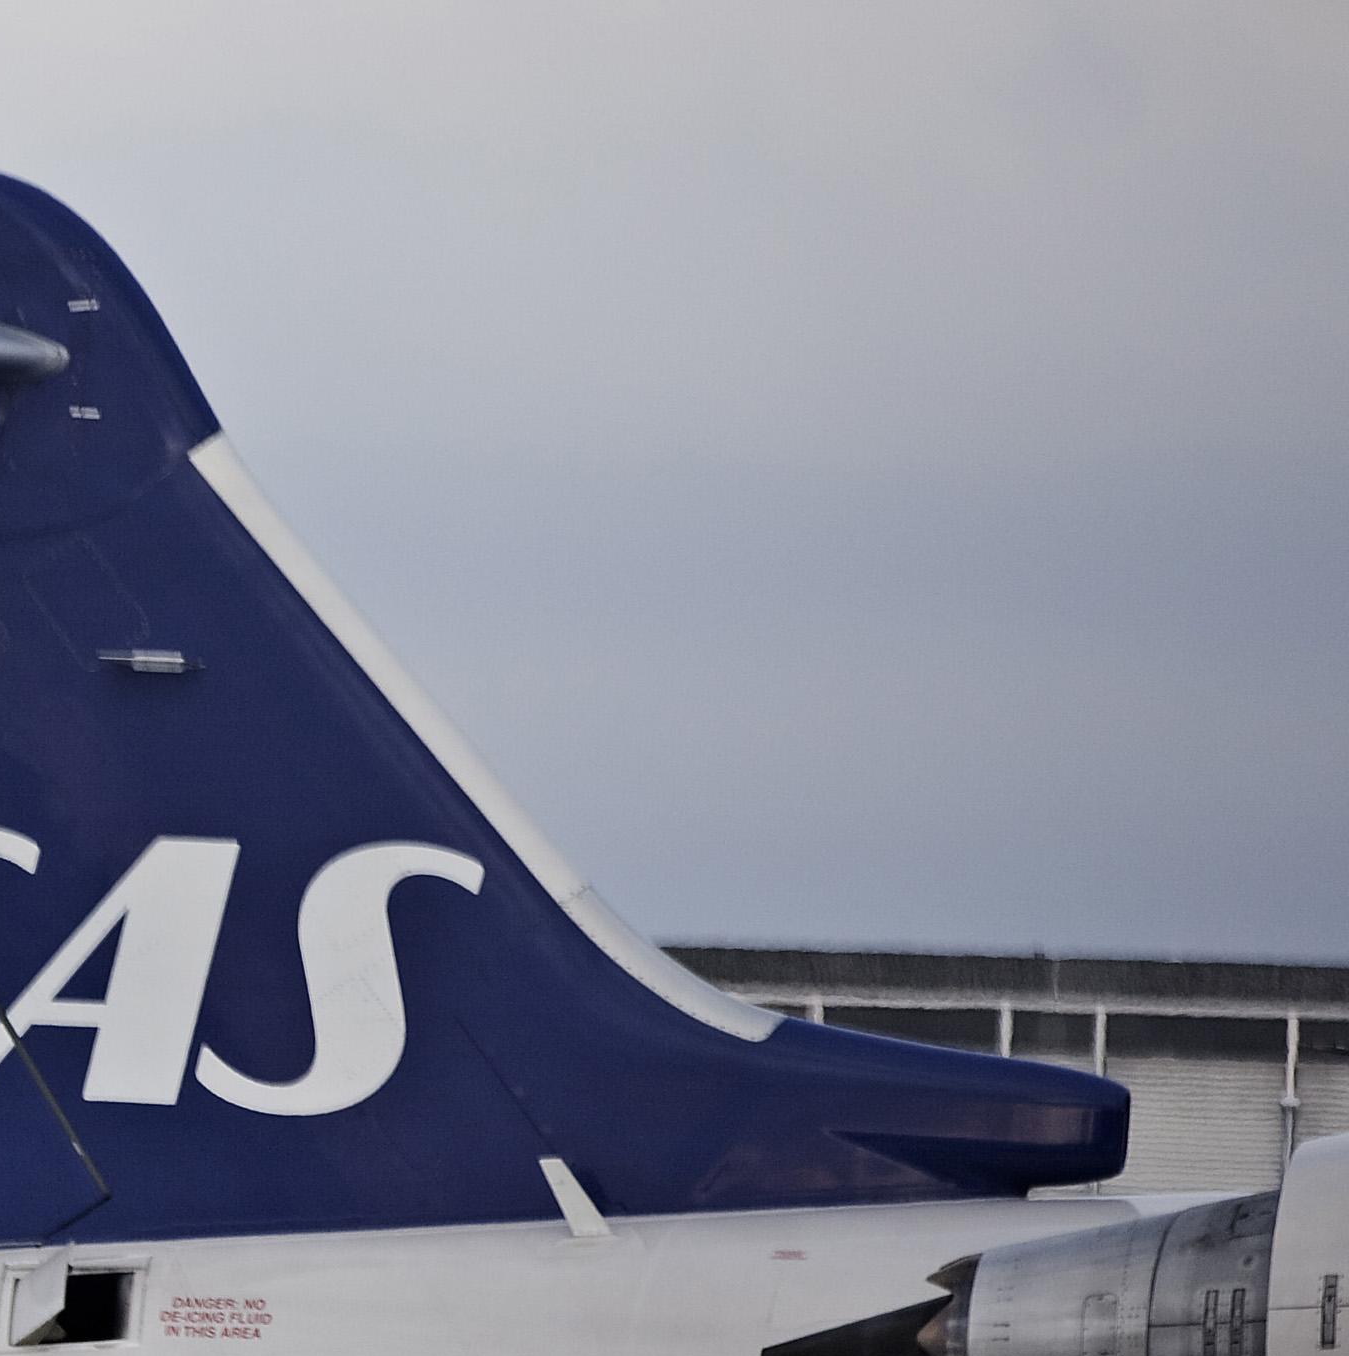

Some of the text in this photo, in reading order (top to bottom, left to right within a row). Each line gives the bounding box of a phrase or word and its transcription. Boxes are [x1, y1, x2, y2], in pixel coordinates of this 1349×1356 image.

[243, 1299, 267, 1311] NO
[159, 1311, 273, 1326] DE-ICING FLUID
[164, 1326, 262, 1340] IN THIS AREA
